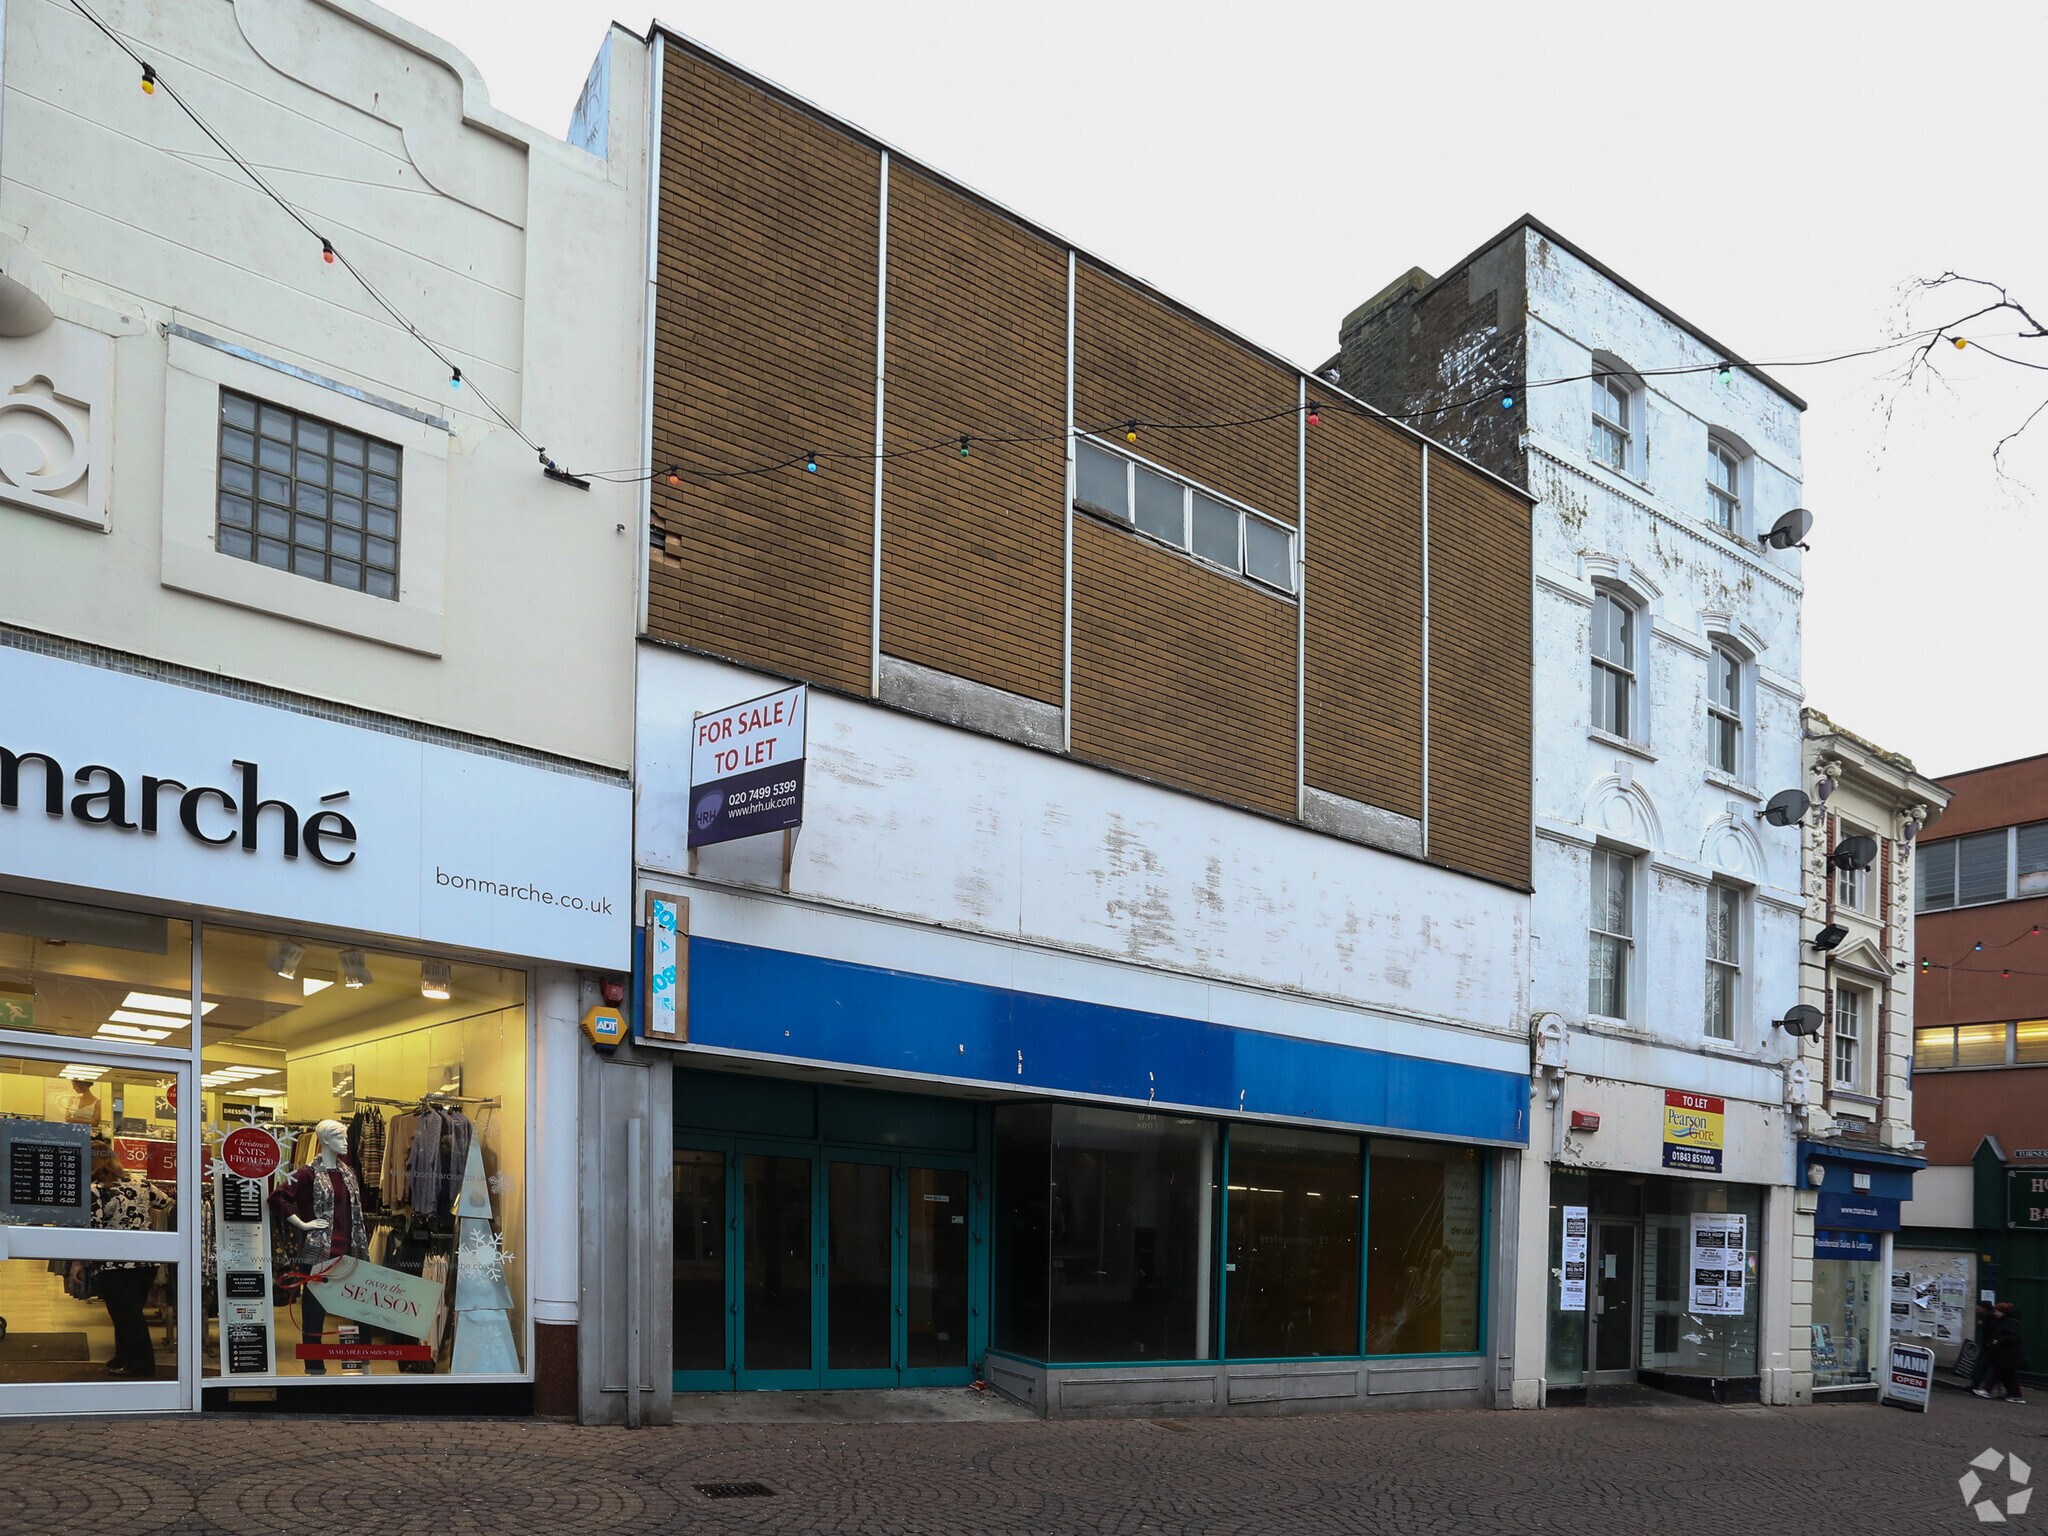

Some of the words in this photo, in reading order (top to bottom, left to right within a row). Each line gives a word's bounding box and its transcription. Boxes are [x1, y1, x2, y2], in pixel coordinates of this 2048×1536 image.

[698, 717, 732, 747] FOR
[738, 701, 784, 735] SALE
[788, 694, 799, 727] /
[714, 748, 739, 774] TO
[744, 738, 777, 767] LET
[729, 793, 747, 806] 020
[749, 786, 770, 802] 7499
[773, 780, 797, 796] 5399
[728, 796, 796, 819] www.hrh.uk.com
[696, 811, 717, 825] HRH
[436, 865, 613, 916] bonmarche.co.uk
[596, 1020, 618, 1033] ADT
[1682, 1095, 1693, 1106] TO
[1695, 1098, 1708, 1109] LET
[1668, 1108, 1707, 1128] Pearson
[1690, 1127, 1714, 1142] Gore
[234, 1138, 270, 1148] Christmas
[238, 1147, 266, 1156] KNITS
[1672, 1151, 1691, 1162] 01843
[1692, 1154, 1714, 1165] 851000
[230, 1155, 256, 1164] FROM
[1841, 1208, 1878, 1216] www.mann.co.uk
[1451, 1226, 1474, 1235] dental
[1260, 1234, 1277, 1245] yes!
[1815, 1238, 1840, 1248] Residential
[1840, 1240, 1851, 1249] Sales
[1856, 1241, 1873, 1252] Lettings
[364, 1278, 390, 1291] own
[390, 1282, 406, 1296] the
[340, 1282, 422, 1318] SEASON
[1893, 1353, 1928, 1373] MANN
[1896, 1375, 1922, 1386] OPEN
